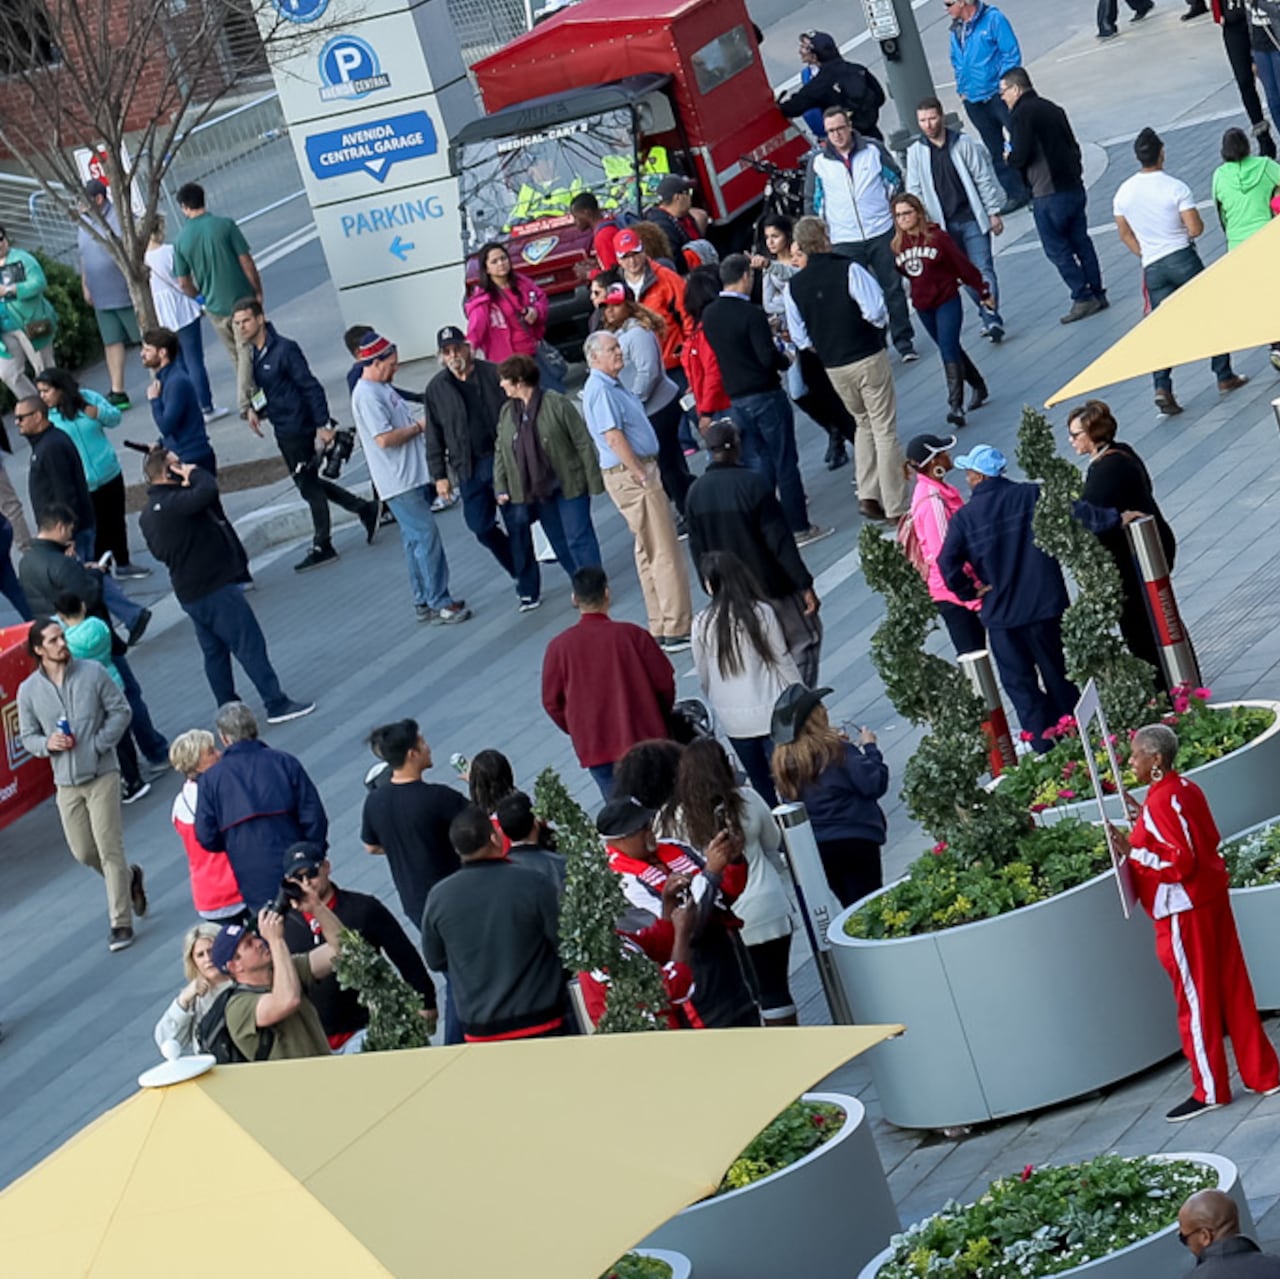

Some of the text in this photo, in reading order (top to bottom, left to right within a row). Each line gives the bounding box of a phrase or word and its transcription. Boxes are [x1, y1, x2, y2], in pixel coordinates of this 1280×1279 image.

[333, 47, 362, 83] P
[353, 73, 391, 96] CENTRAL
[341, 124, 395, 147] AVENIDA
[497, 134, 546, 154] MEDICAL
[319, 131, 425, 167] CENTRAL GARAGE
[341, 195, 445, 238] PARKING
[894, 246, 939, 268] HARVARD
